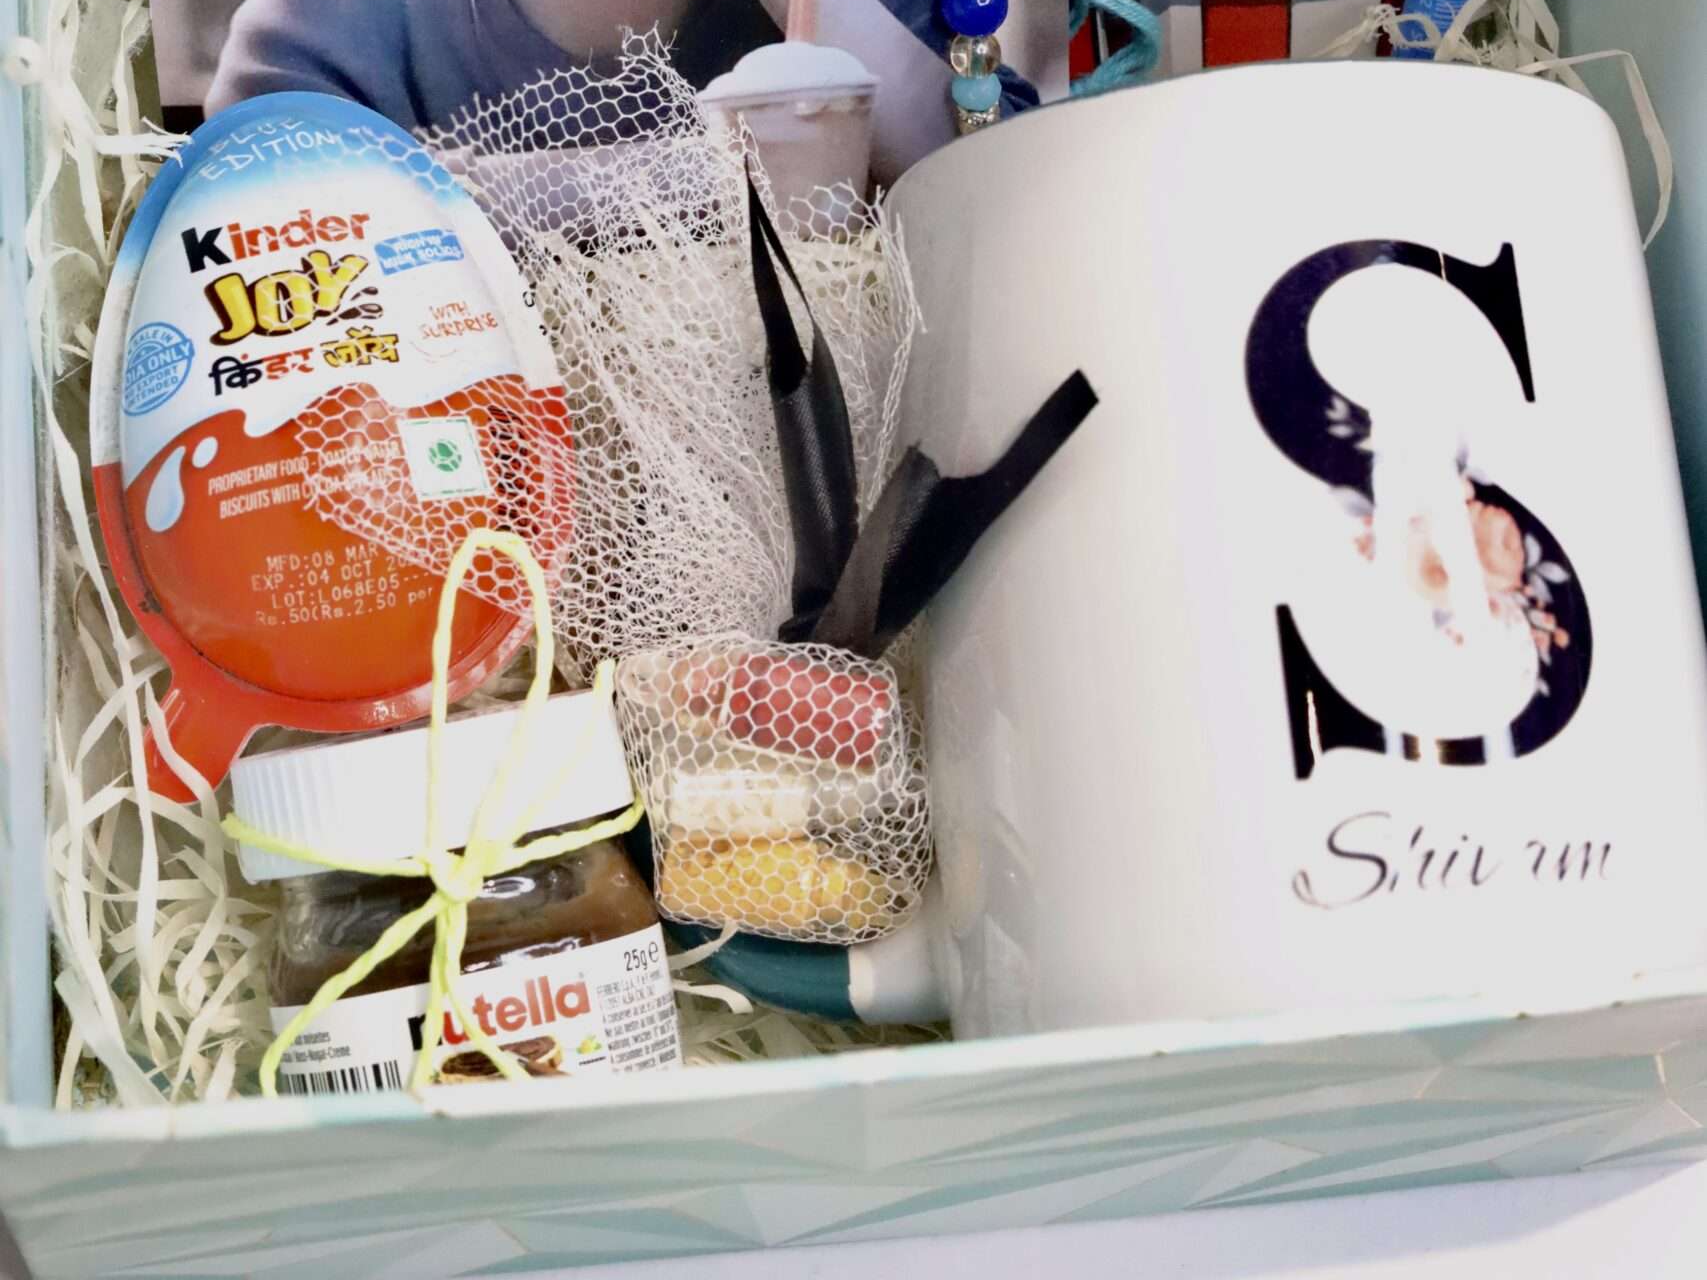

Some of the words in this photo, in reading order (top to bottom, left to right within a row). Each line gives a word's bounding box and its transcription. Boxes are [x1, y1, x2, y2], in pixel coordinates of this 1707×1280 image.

[200, 130, 342, 180] EDITION
[181, 209, 370, 273] Kinder
[204, 250, 369, 346] JOY
[148, 341, 191, 371] ONLY
[208, 460, 278, 496] PROPRIETARY
[279, 455, 310, 478] FOOD
[220, 489, 271, 520] BISCUITS
[271, 483, 301, 505] WITH
[1244, 239, 1592, 781] S
[341, 559, 374, 581] OCT
[345, 542, 379, 563] MAR
[624, 948, 648, 972] 25g
